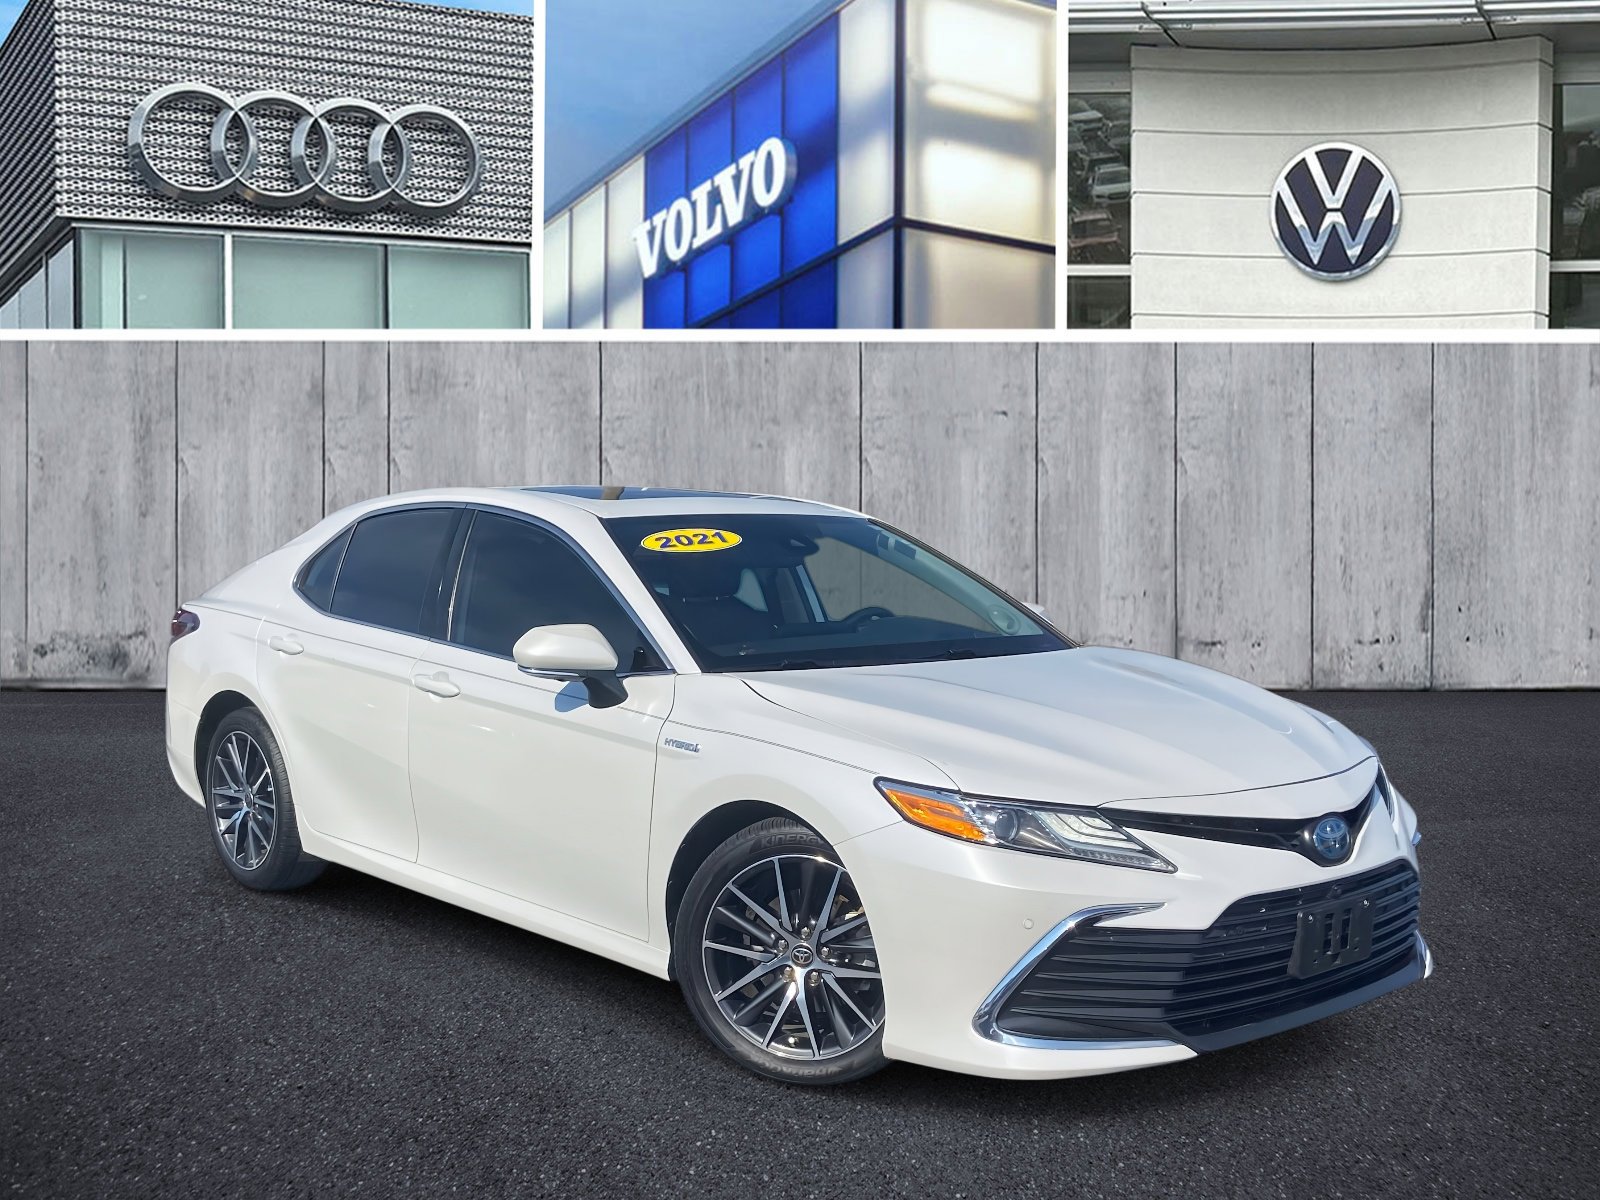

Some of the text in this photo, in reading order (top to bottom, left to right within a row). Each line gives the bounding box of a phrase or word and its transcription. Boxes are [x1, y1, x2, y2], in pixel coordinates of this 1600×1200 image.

[633, 137, 788, 278] VOLVO
[1274, 145, 1397, 267] VW
[655, 531, 728, 549] 2021
